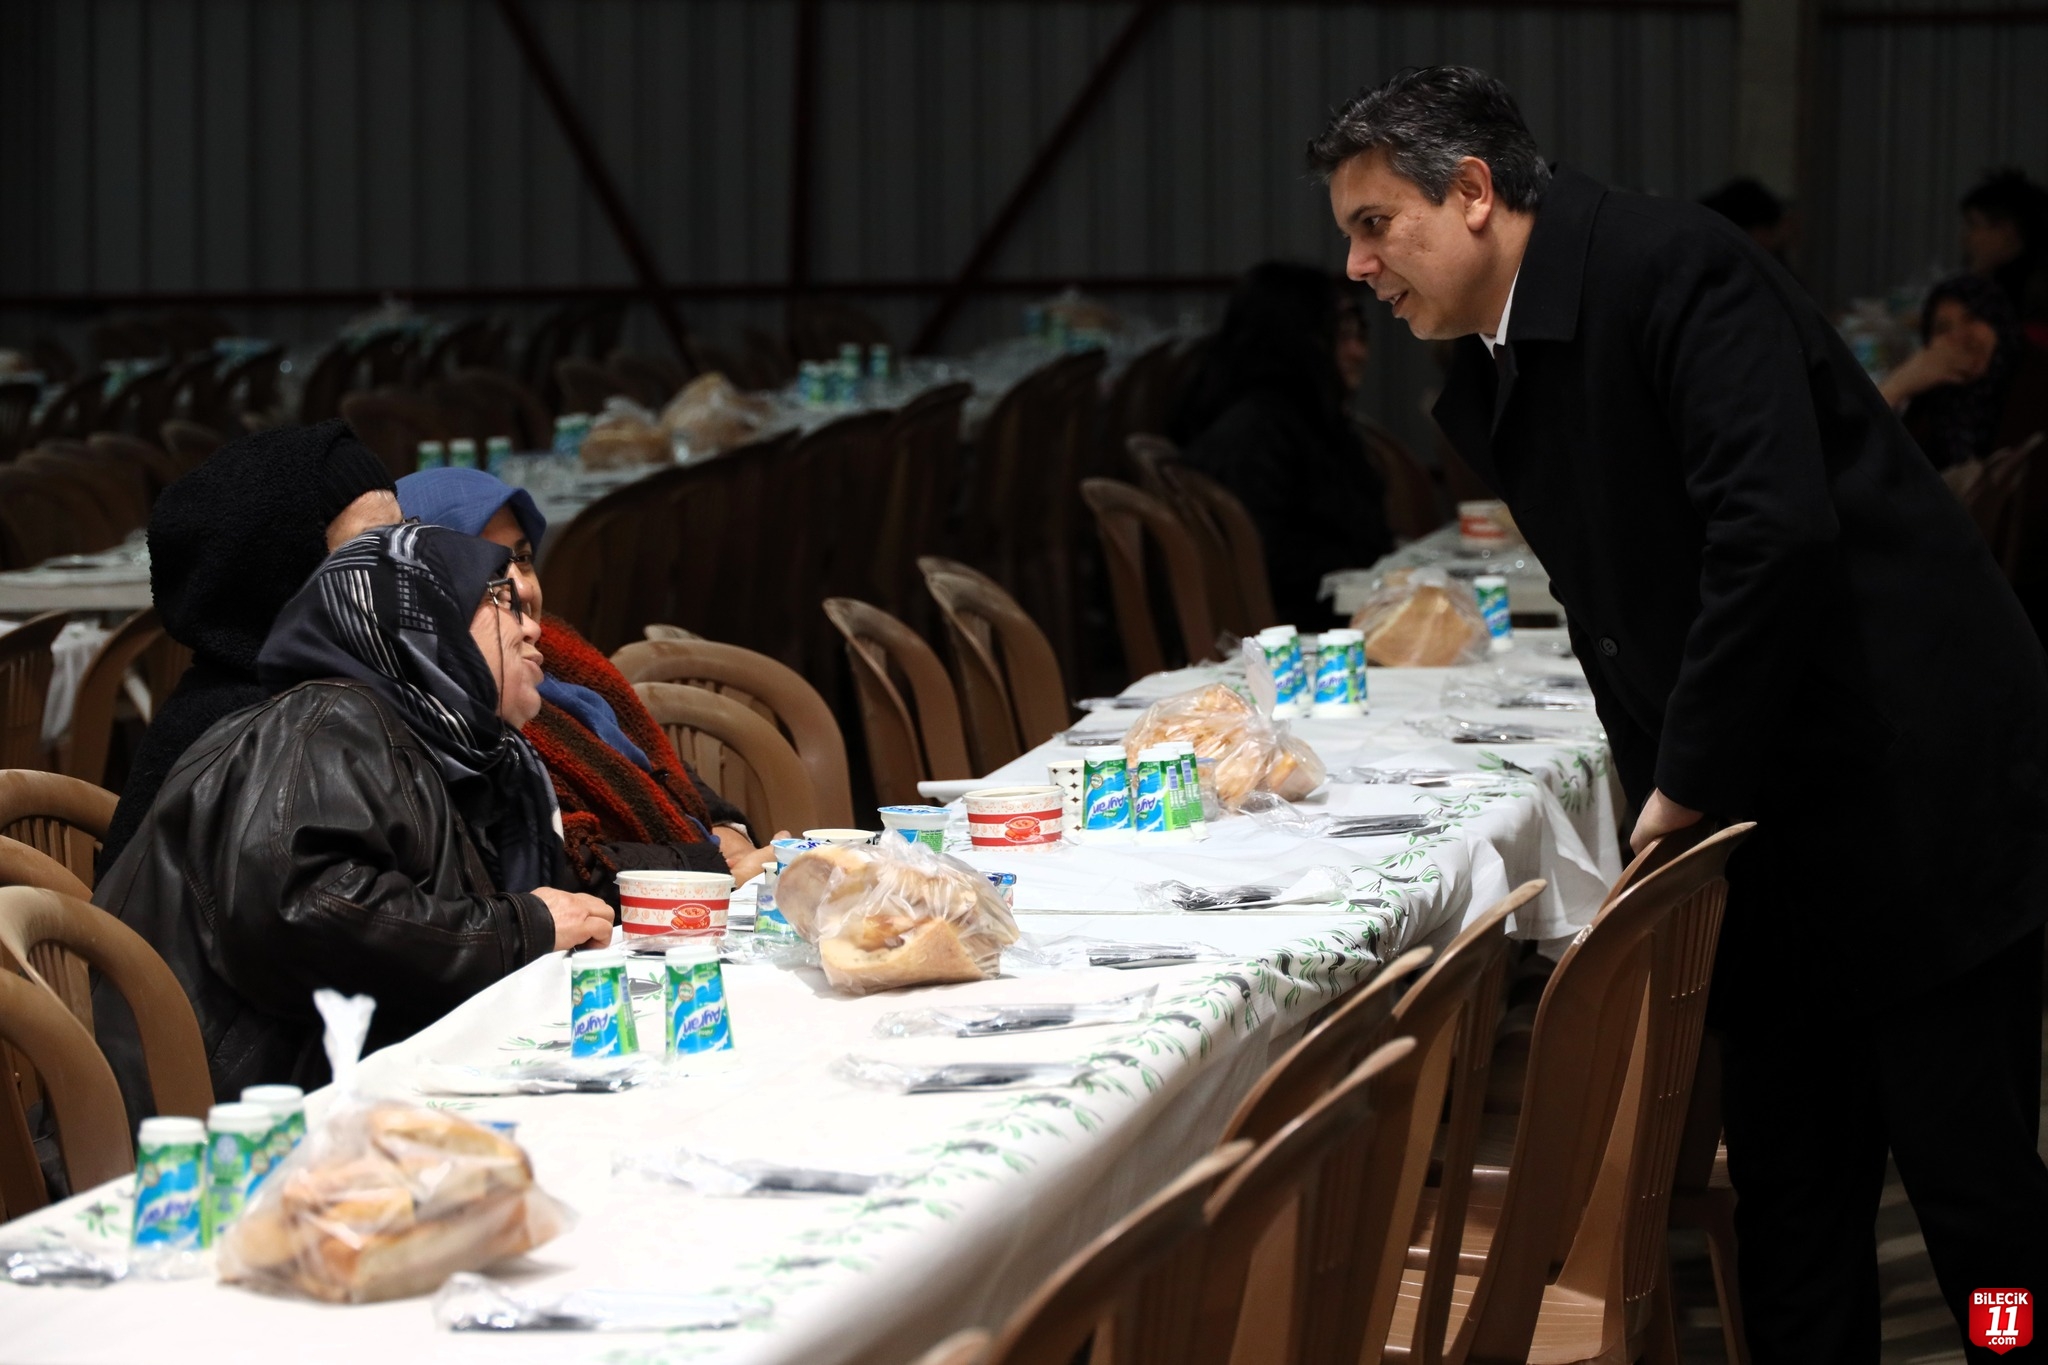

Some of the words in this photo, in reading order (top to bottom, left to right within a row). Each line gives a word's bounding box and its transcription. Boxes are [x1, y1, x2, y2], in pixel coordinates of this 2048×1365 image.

[1093, 795, 1124, 814] Ayran
[1136, 797, 1156, 813] Ayra
[683, 1006, 721, 1034] Ayran
